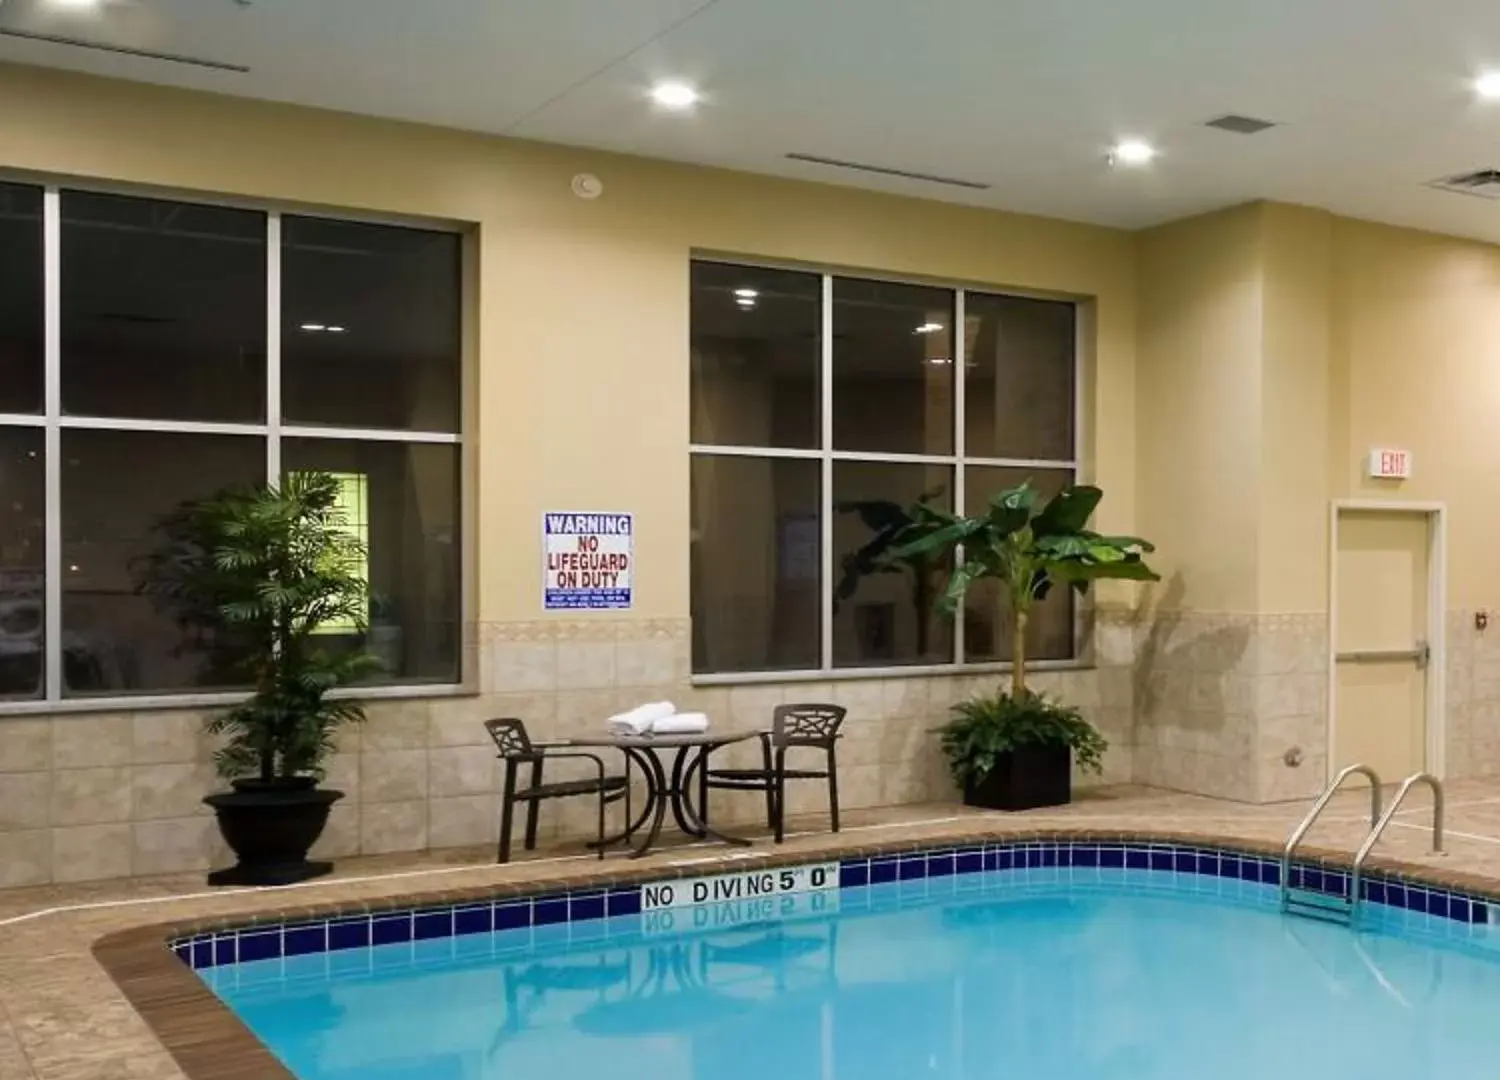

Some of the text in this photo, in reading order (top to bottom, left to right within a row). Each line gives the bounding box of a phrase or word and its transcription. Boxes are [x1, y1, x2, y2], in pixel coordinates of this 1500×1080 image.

[1381, 452, 1405, 474] EXIT
[547, 515, 629, 533] WARNING
[578, 535, 599, 552] NO
[548, 553, 628, 570] LIFEGUARD
[557, 571, 618, 588] ON DUTY
[645, 885, 673, 908] NO
[693, 874, 773, 902] DIVING
[779, 871, 794, 890] 5
[811, 867, 825, 887] 0
